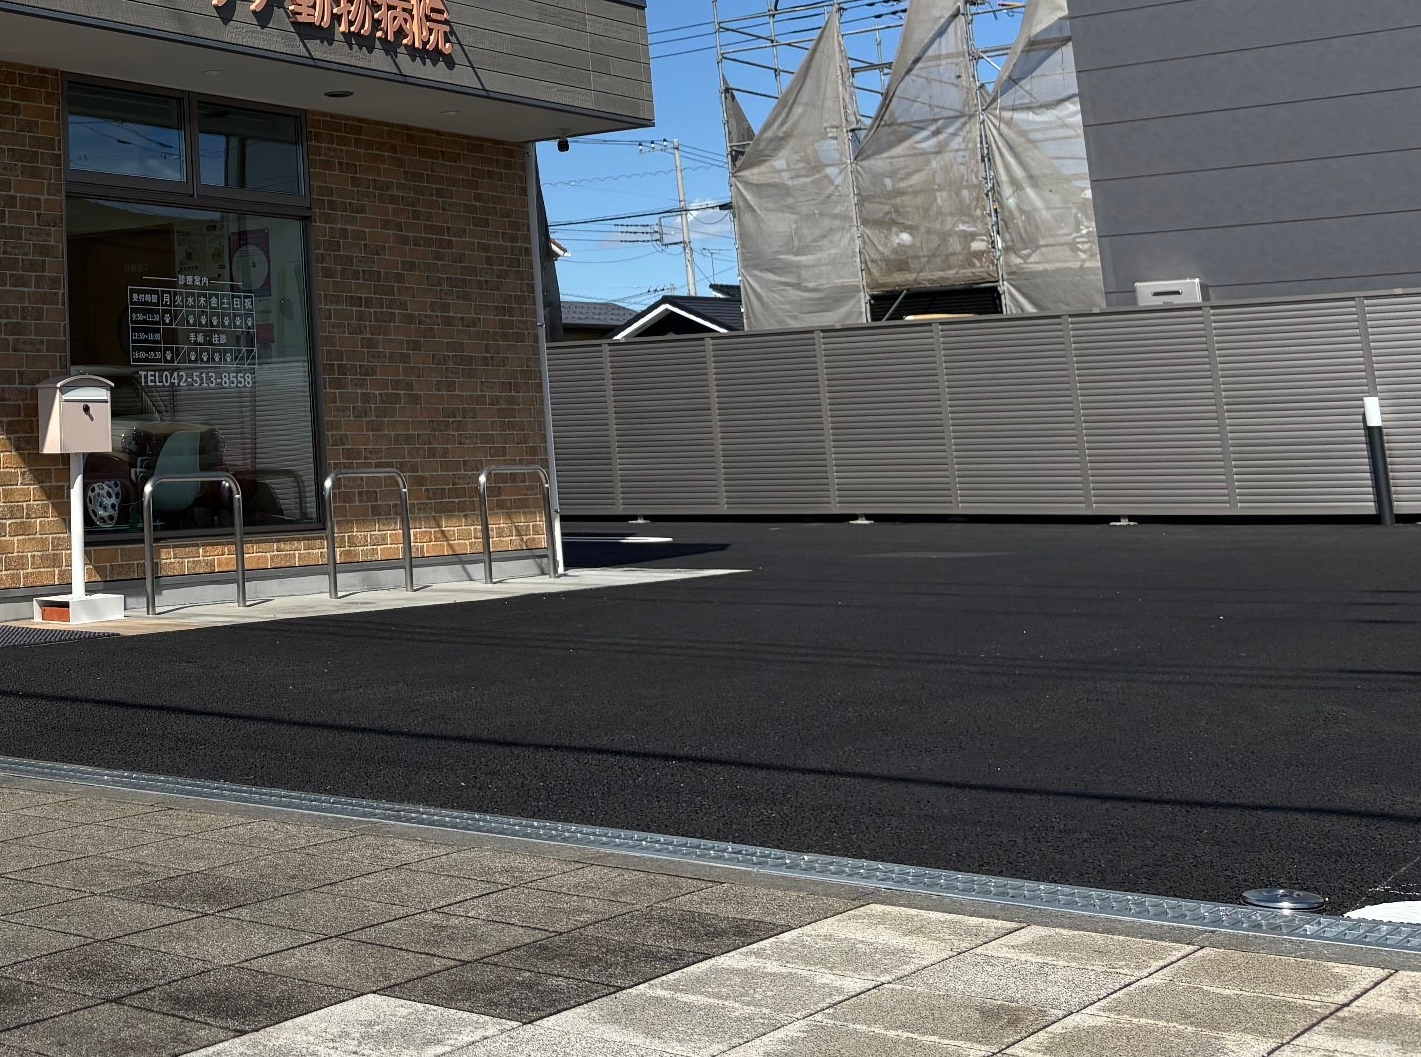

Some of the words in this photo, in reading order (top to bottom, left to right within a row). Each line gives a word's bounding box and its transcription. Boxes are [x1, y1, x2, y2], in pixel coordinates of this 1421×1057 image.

[178, 275, 209, 286] 診療案内
[132, 293, 158, 303] 受付時間
[163, 294, 170, 305] 月
[175, 295, 182, 305] 火
[186, 295, 195, 306] 水
[198, 296, 207, 307] 木
[210, 296, 219, 307] 金
[222, 297, 230, 308] 土
[233, 297, 241, 308] 日
[244, 298, 253, 309] 祝
[139, 371, 253, 388] TEL042-513-8558
